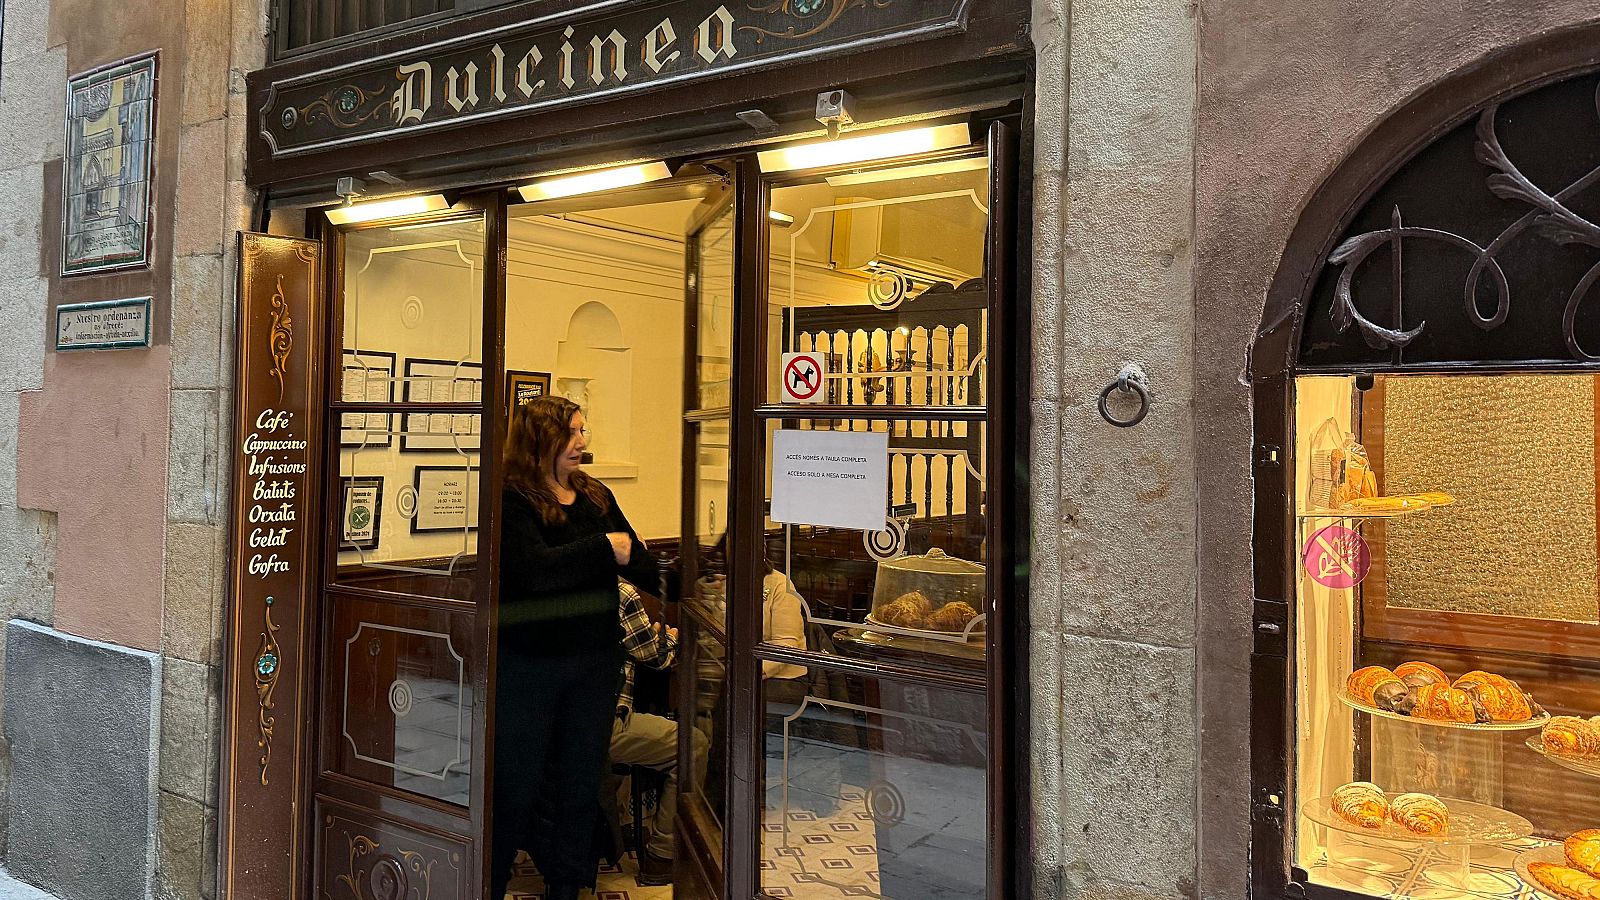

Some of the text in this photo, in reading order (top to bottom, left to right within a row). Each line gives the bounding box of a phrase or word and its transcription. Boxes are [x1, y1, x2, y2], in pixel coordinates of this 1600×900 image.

[391, 4, 738, 126] Dulcinea
[103, 310, 142, 321] ordenanza
[243, 432, 307, 455] Cappuccino
[248, 454, 307, 480] Infusions
[252, 479, 296, 501] Batuts
[248, 502, 296, 523] Orxata
[249, 527, 294, 548] Gelat
[248, 553, 290, 580] Gofra
